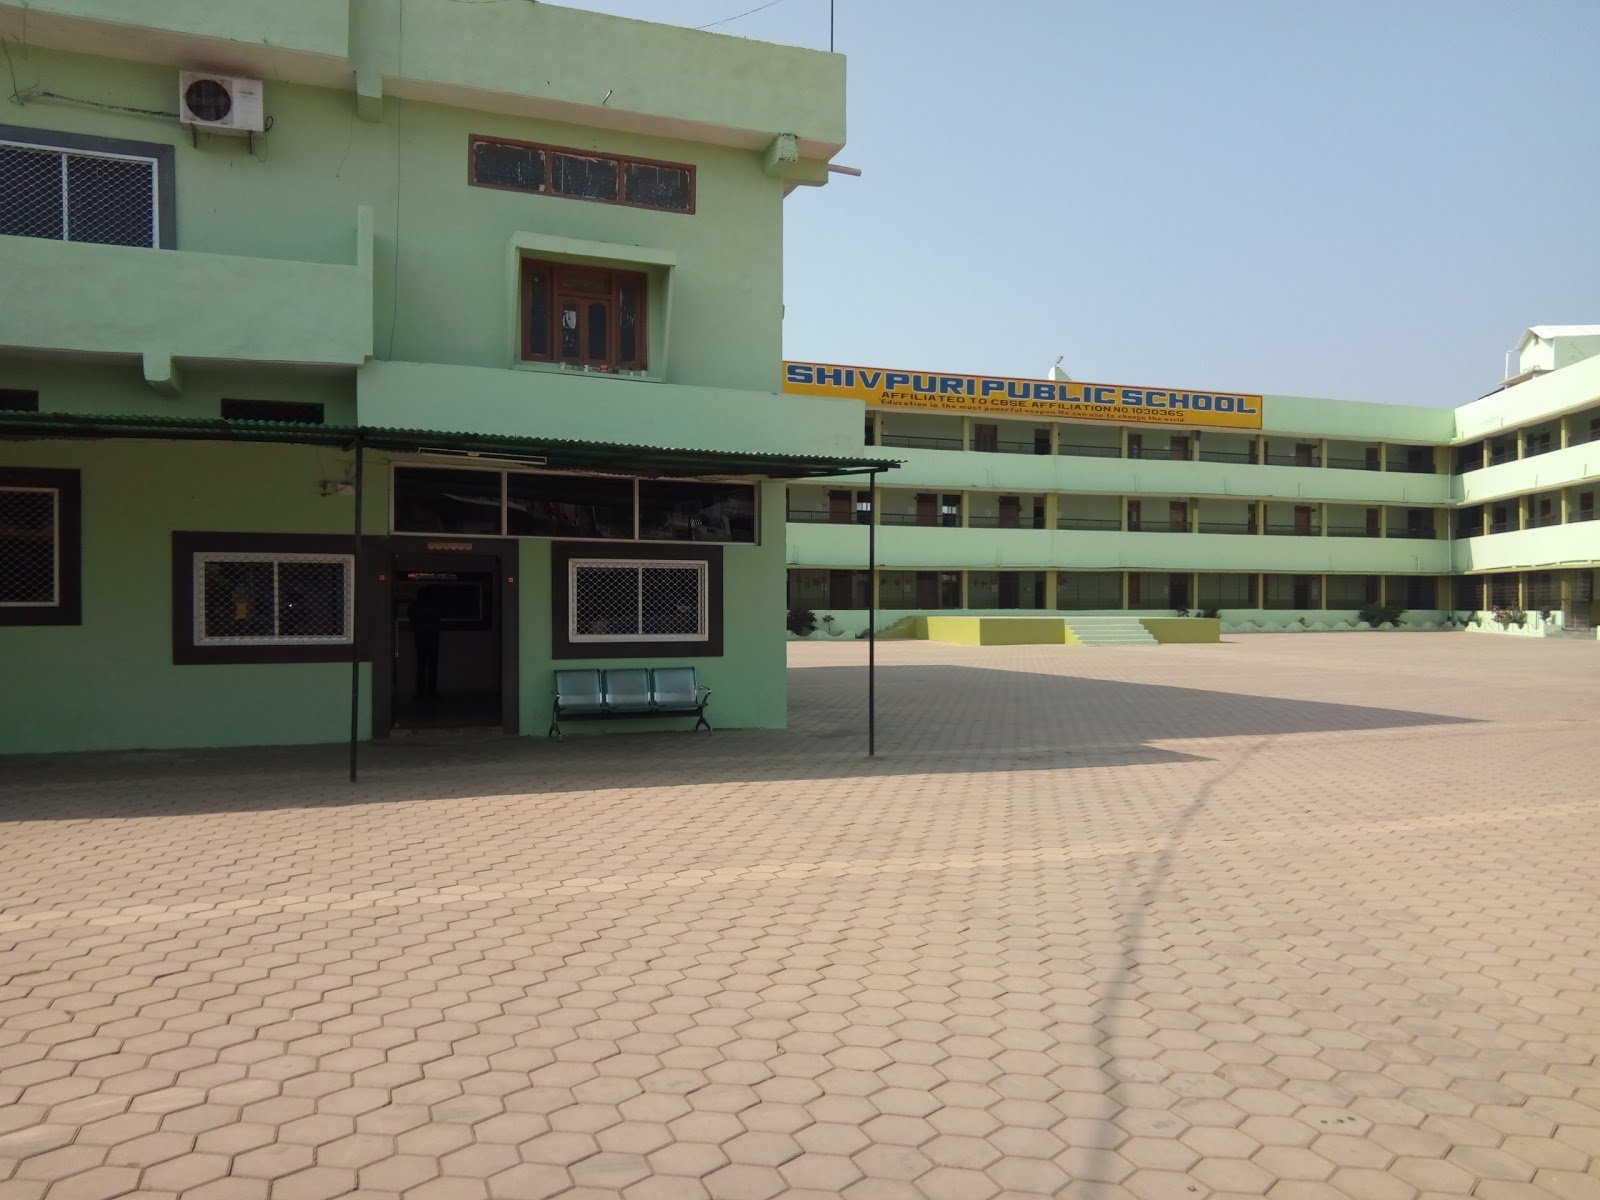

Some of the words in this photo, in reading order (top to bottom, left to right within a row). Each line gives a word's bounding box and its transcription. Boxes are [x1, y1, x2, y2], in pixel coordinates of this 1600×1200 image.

[786, 364, 976, 397] SHIVPURI
[980, 379, 1117, 406] PUBLIC
[1121, 388, 1258, 415] SCHOOL
[881, 391, 965, 404] AFFILIATED
[969, 396, 987, 405] TO
[991, 399, 1027, 408] CBSE
[1031, 401, 1112, 413] AFFILIATION
[1132, 407, 1184, 417] 1030365
[881, 399, 927, 407] Education
[1117, 413, 1147, 421] change
